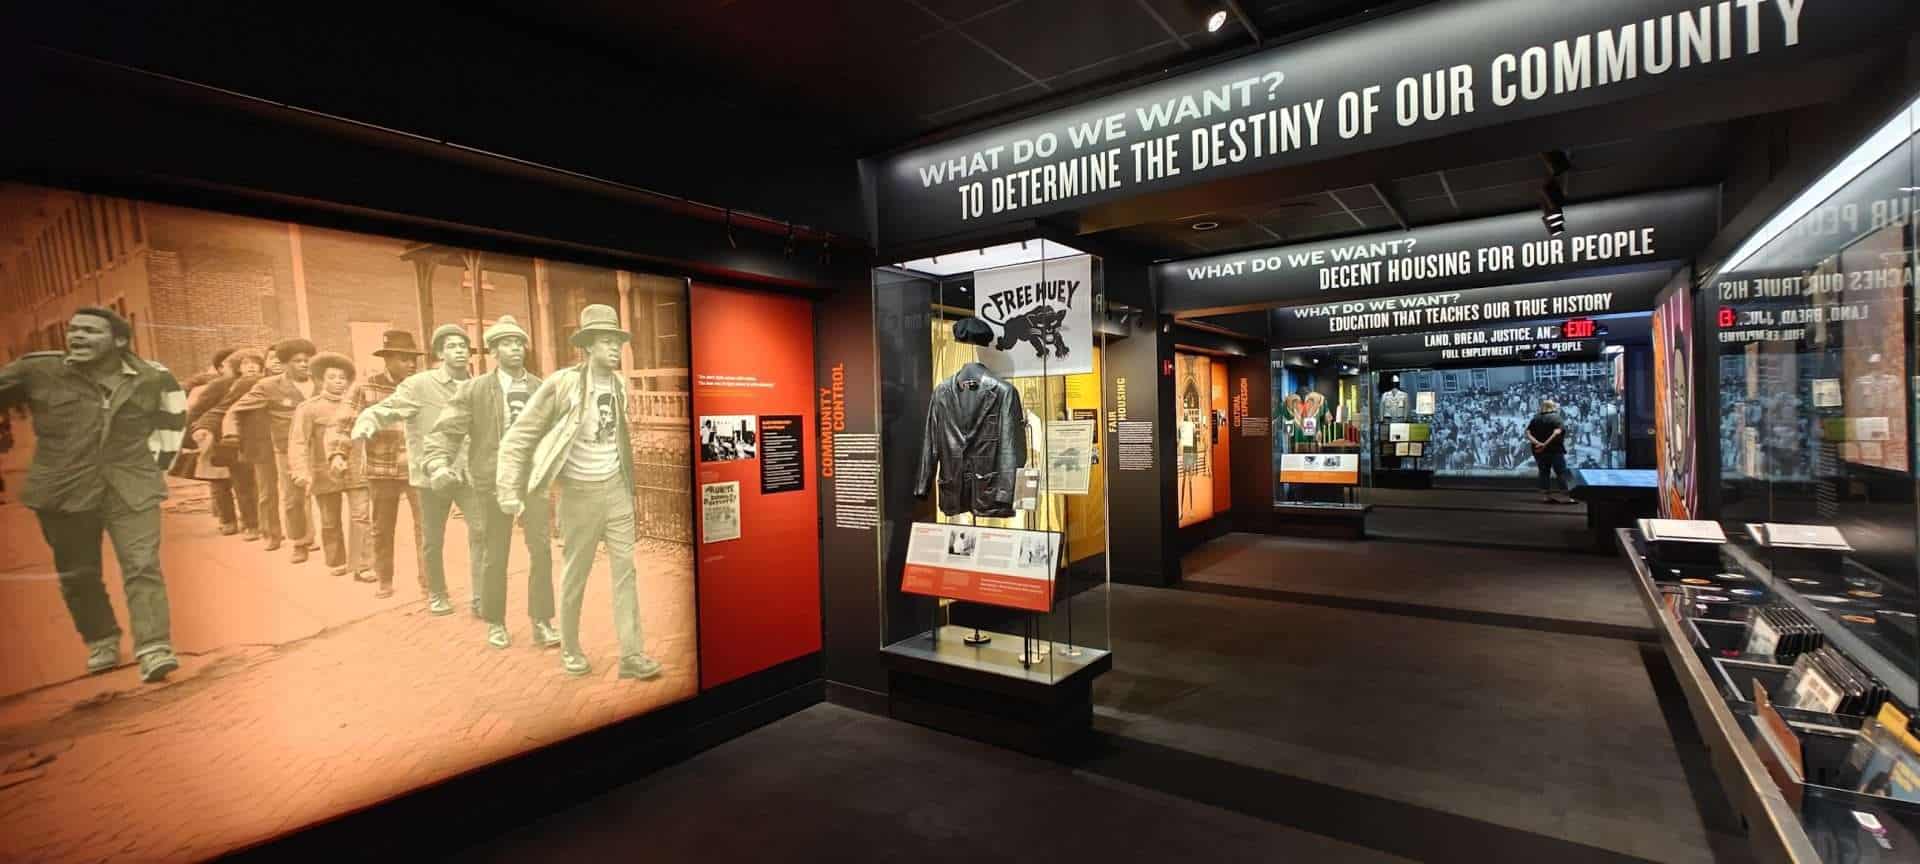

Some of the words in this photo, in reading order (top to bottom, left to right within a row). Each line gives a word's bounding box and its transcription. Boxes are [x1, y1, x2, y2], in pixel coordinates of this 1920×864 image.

[919, 146, 1004, 188] WHAT
[1013, 133, 1058, 165] DO
[1068, 113, 1126, 149] WE
[1136, 71, 1285, 131] WANT?
[958, 182, 984, 220] TO
[992, 148, 1121, 214] DETERMINE
[1130, 134, 1180, 183] THE
[1192, 99, 1325, 171] DESTINY
[1338, 85, 1380, 139] OF
[1395, 64, 1474, 128] OUR
[1491, 0, 1803, 107] COMMUNITY
[1187, 260, 1246, 281] WHAT
[1252, 256, 1281, 273] DO
[1287, 250, 1325, 268] WE
[1330, 238, 1417, 262] WANT?
[1319, 261, 1382, 290] DECENT
[1388, 250, 1471, 282] HOUSING
[1478, 246, 1514, 273] FOR
[1521, 239, 1564, 267] OUR
[1572, 228, 1654, 262] PEOPLE
[988, 285, 1032, 320] FREE
[1036, 280, 1080, 310] HUEY
[1294, 304, 1339, 319] WHAT
[1343, 302, 1365, 314] DO
[1369, 299, 1396, 311] WE
[1400, 293, 1461, 309] WANT?
[1329, 314, 1389, 332] EDUCATION
[1393, 309, 1421, 327] THAT
[1427, 306, 1479, 324] TEACHES
[1484, 301, 1511, 319] OUR
[1514, 298, 1548, 316] TRUE
[1553, 292, 1613, 313] HISTORY
[1567, 321, 1593, 337] EXIT
[1442, 348, 1460, 359] FULL
[1462, 344, 1512, 357] EMPLOYMENT
[832, 362, 845, 431] CONTROL
[1116, 377, 1127, 421] HOUSING
[820, 387, 833, 478] COMMUNITY
[1108, 411, 1117, 432] FAIR
